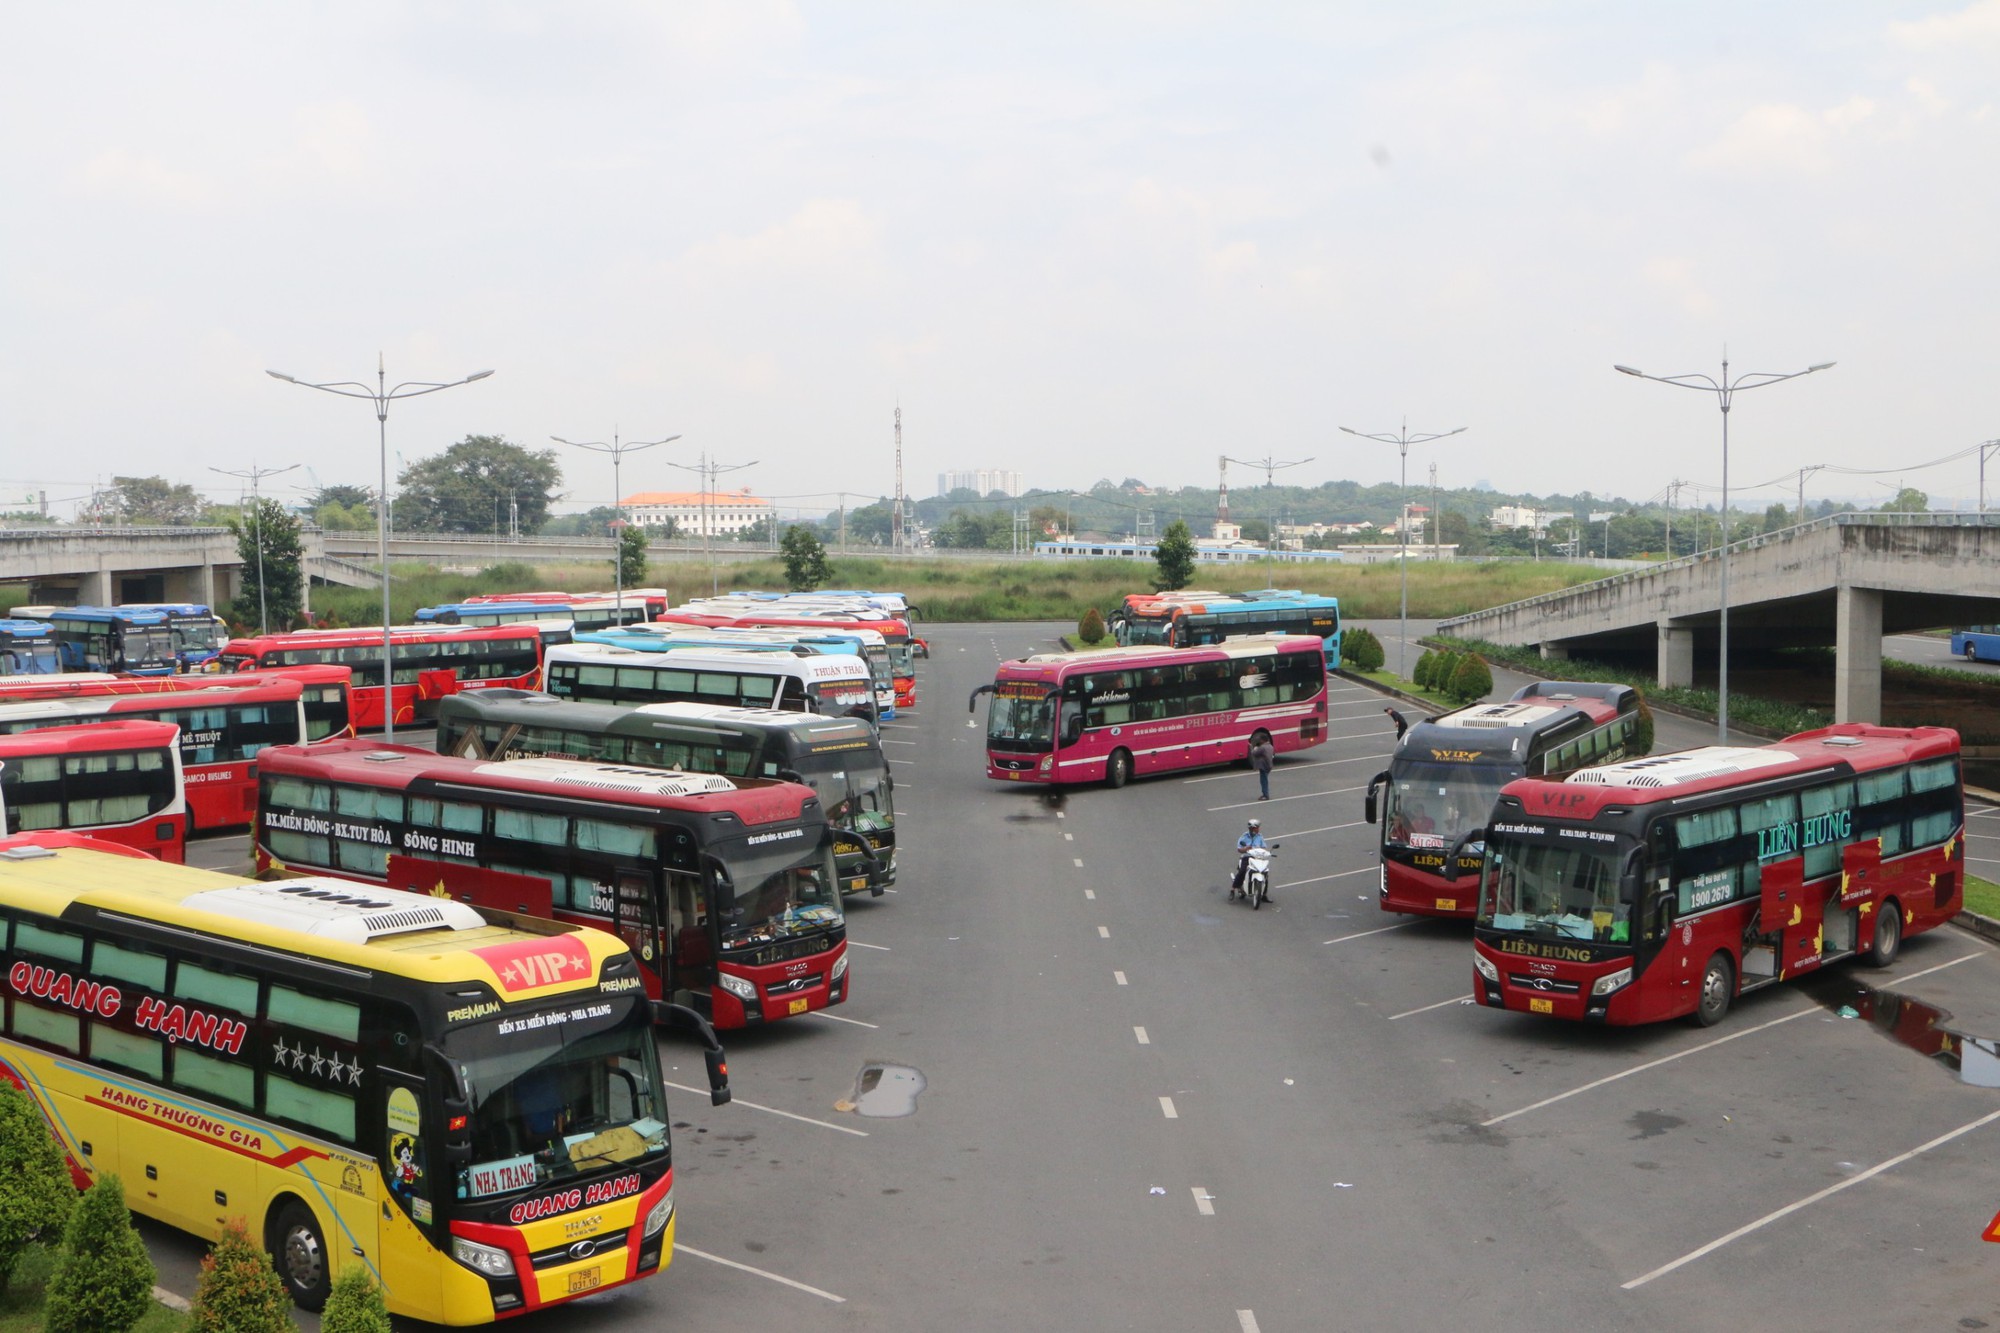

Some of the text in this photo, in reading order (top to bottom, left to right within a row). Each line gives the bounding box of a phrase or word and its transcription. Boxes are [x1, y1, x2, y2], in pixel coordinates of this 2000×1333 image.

[813, 664, 841, 678] THUẬN
[1186, 714, 1233, 729] PHI HIỆP
[182, 730, 222, 744] MÊ THUỘT
[1442, 750, 1469, 759] VIP
[183, 773, 206, 784] SAMCO
[1542, 791, 1586, 808] VIP
[303, 815, 330, 835] ĐÔNG
[1757, 809, 1852, 860] LIÊN HƯNG
[334, 822, 475, 858] BX.TUY HÒA SÔNG HINH
[1413, 854, 1444, 867] LIÊN
[589, 895, 614, 913] 1900
[1691, 885, 1731, 909] 1900 2679
[1502, 939, 1591, 962] LIÊN HƯNG
[511, 952, 567, 986] VIP
[1528, 961, 1557, 971] THACO
[600, 977, 641, 993] PREMIUM
[10, 962, 247, 1054] QUANG HẠNH
[447, 1000, 501, 1022] PREMIUM
[498, 1019, 515, 1035] BẾN
[515, 1019, 527, 1032] XE
[546, 1011, 567, 1026] ĐÔNG
[571, 1007, 587, 1021] NHA
[587, 1004, 612, 1019] TRANG
[101, 1086, 262, 1151] HẠNG THƯƠNG GIA
[475, 1163, 535, 1196] NHA TRANG
[510, 1173, 641, 1224] QUANG HẠNH
[564, 1215, 602, 1233] THACO
